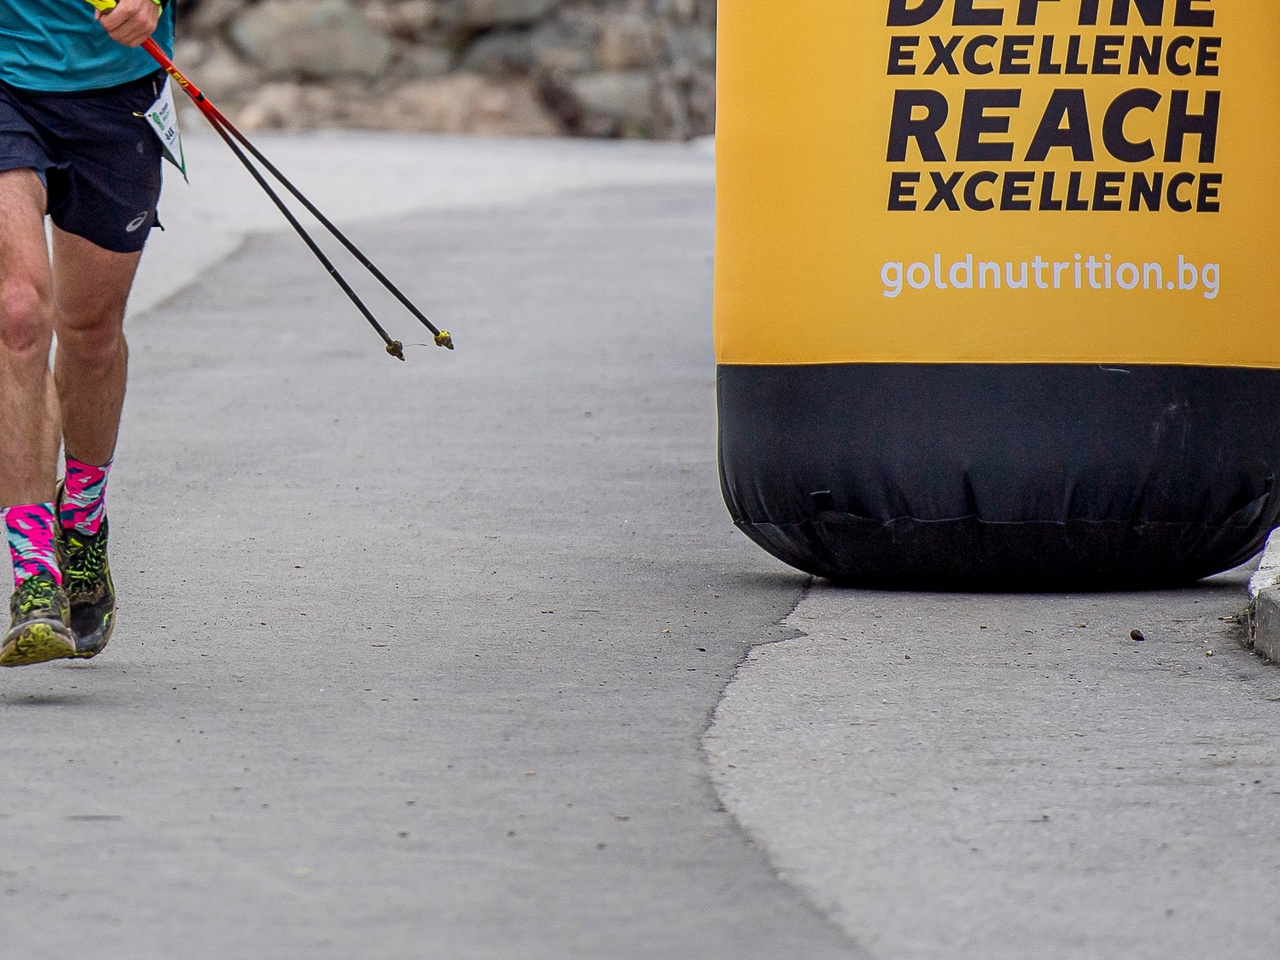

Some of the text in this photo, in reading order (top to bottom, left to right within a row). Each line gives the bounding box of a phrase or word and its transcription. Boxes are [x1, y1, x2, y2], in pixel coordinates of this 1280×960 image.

[886, 34, 1222, 77] EXCELLENCE
[885, 87, 1221, 164] REACH
[887, 170, 1223, 213] EXCELLENCE
[880, 252, 1221, 300] goldnutrition.bg
